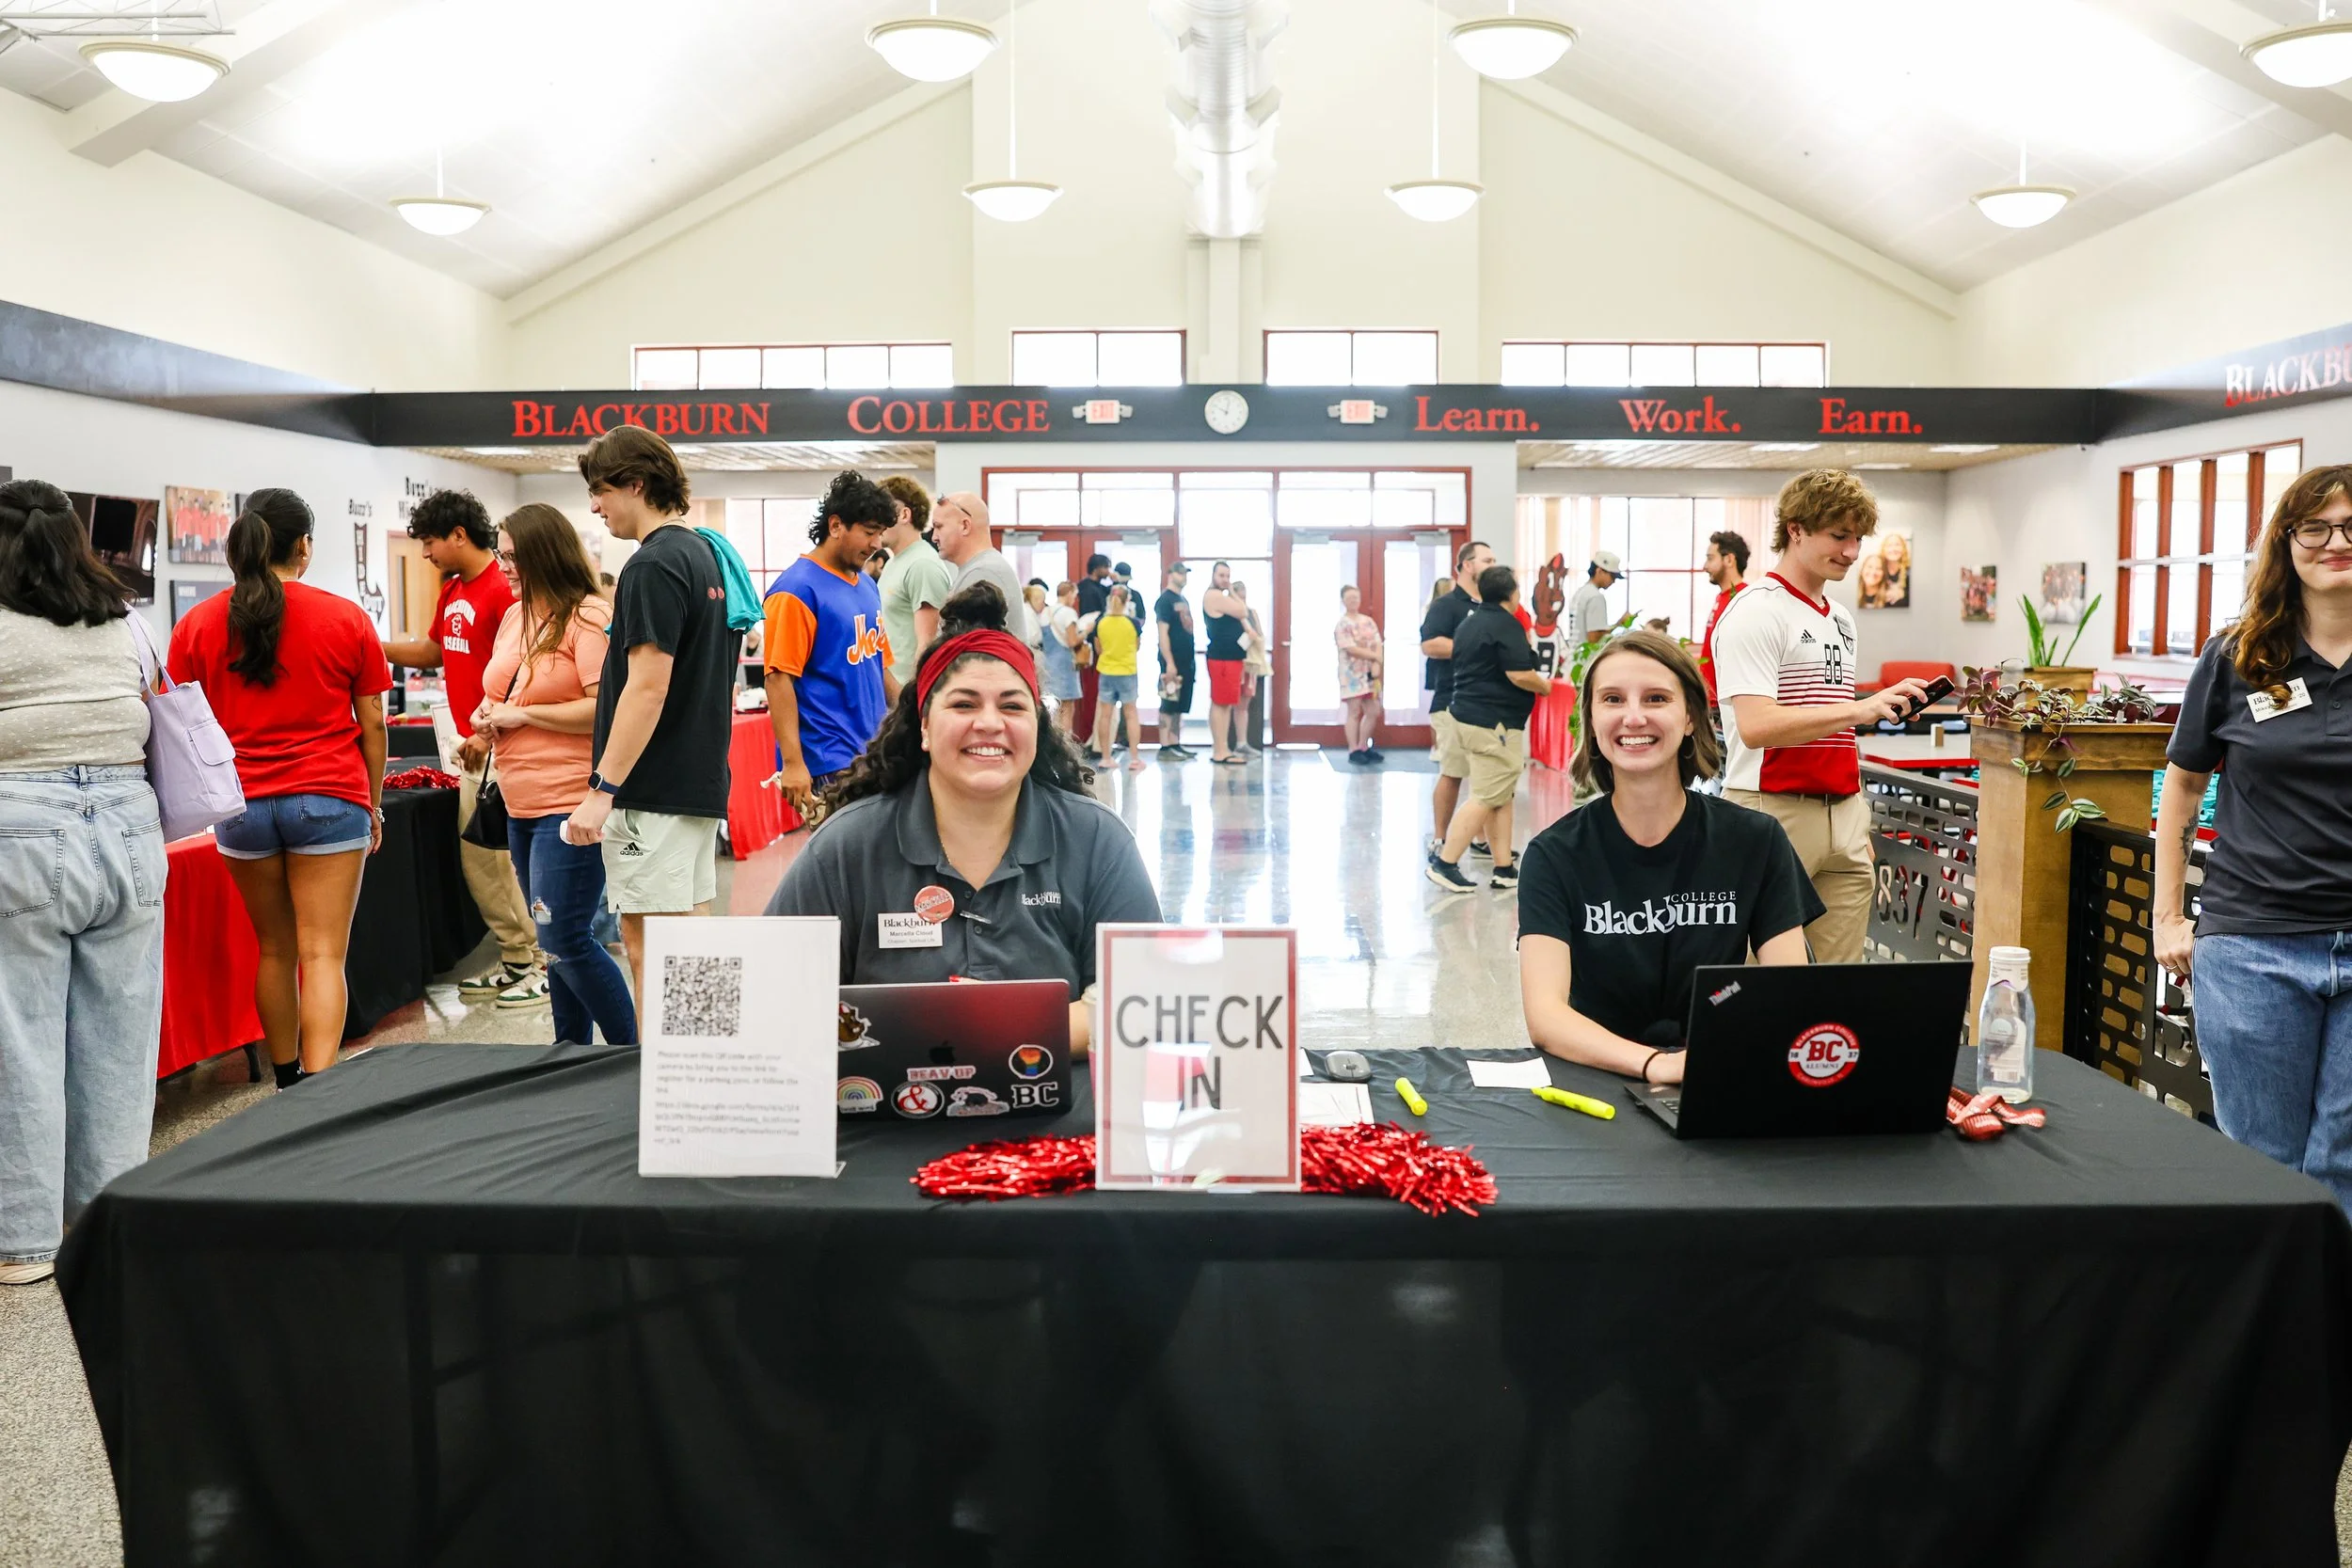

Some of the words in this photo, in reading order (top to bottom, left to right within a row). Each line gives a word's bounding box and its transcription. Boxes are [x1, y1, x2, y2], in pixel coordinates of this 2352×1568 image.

[511, 399, 771, 437] BLACKBURN
[847, 395, 1051, 434] COLLEGE
[1413, 395, 1540, 434] Learn.
[1620, 395, 1741, 434] Work.
[1818, 398, 1923, 435] Earn.
[2253, 684, 2300, 705] Blacn
[1583, 895, 1738, 935] Blackburn
[1671, 891, 1737, 903] COLLEGE
[1116, 994, 1283, 1049] CHECK
[1806, 1039, 1843, 1062] BC
[1012, 1083, 1057, 1107] BC
[1177, 1055, 1221, 1111] IN
